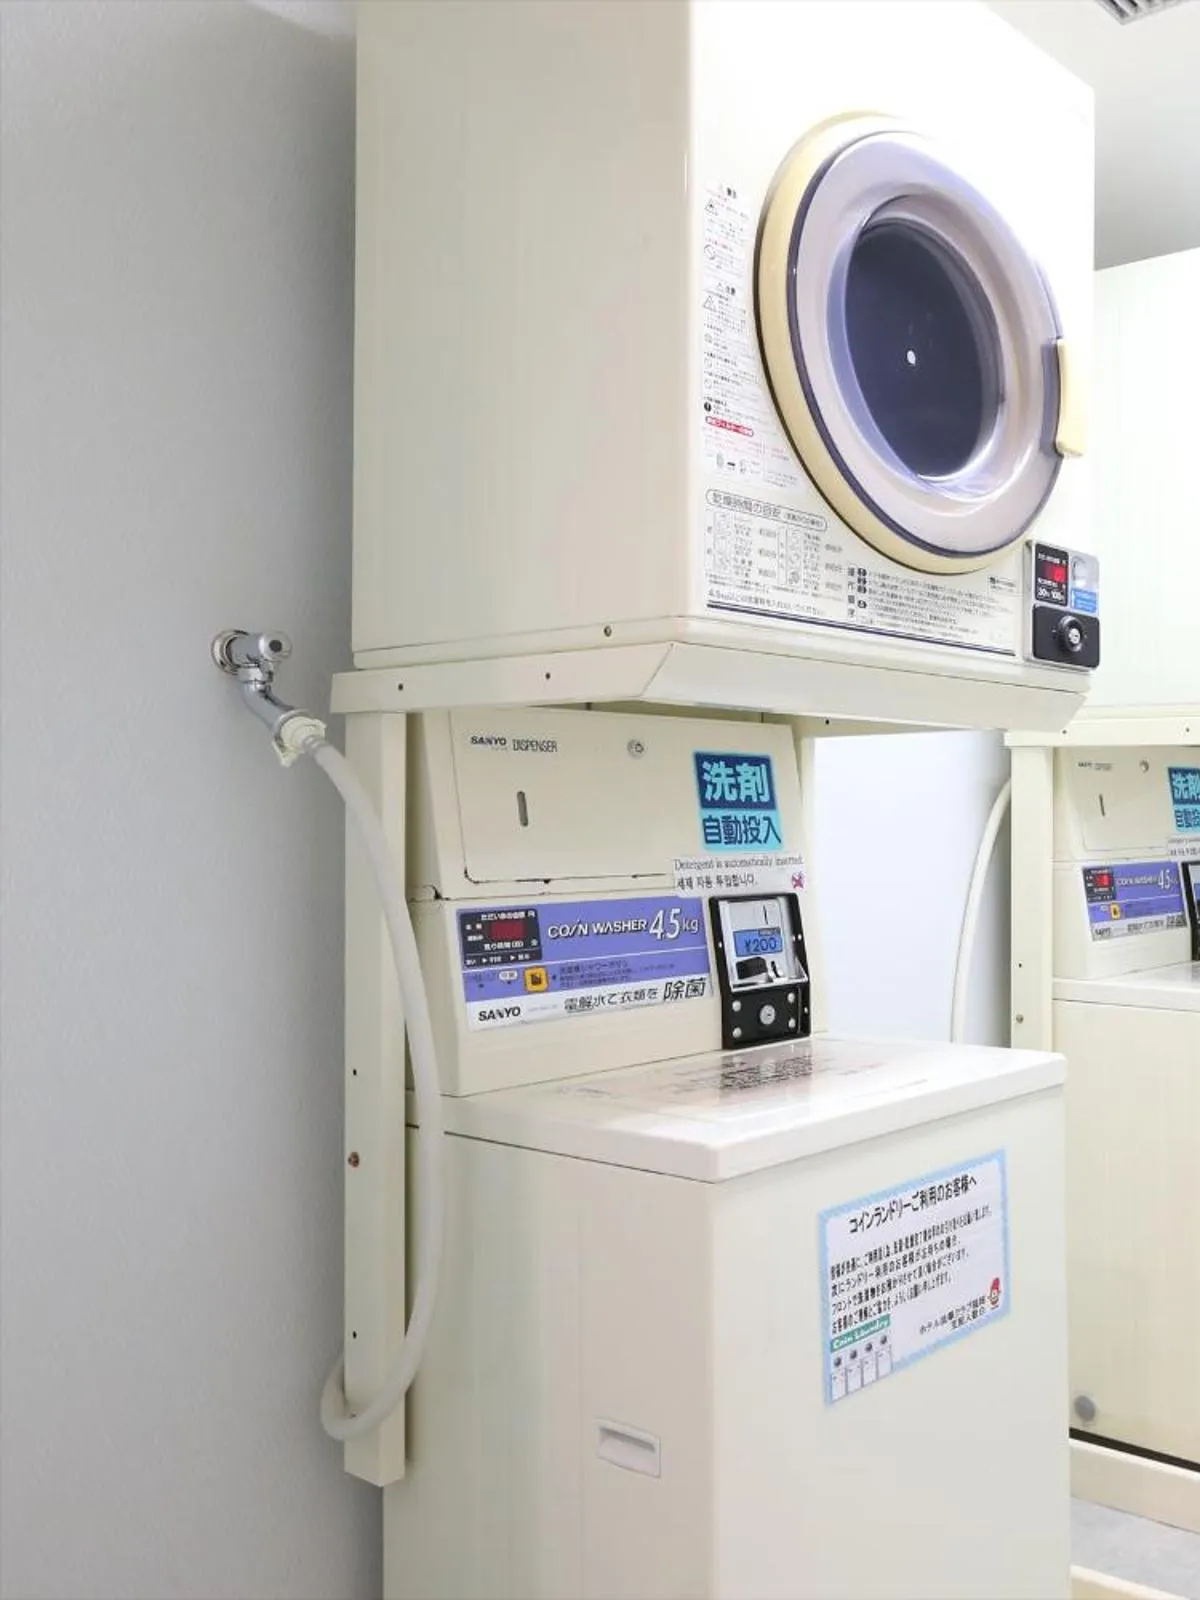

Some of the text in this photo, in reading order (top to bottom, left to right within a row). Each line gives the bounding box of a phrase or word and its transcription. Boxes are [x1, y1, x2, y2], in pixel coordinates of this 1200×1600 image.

[471, 735, 507, 746] SANYO
[702, 761, 770, 802] 洗剤
[702, 815, 781, 844] 自動投入
[548, 918, 589, 939] COIN
[592, 918, 647, 936] WASHER
[664, 978, 706, 1001] 除菌
[478, 1006, 521, 1021] SANYO
[850, 1174, 977, 1233] コインランドリーご利用のお客様へ
